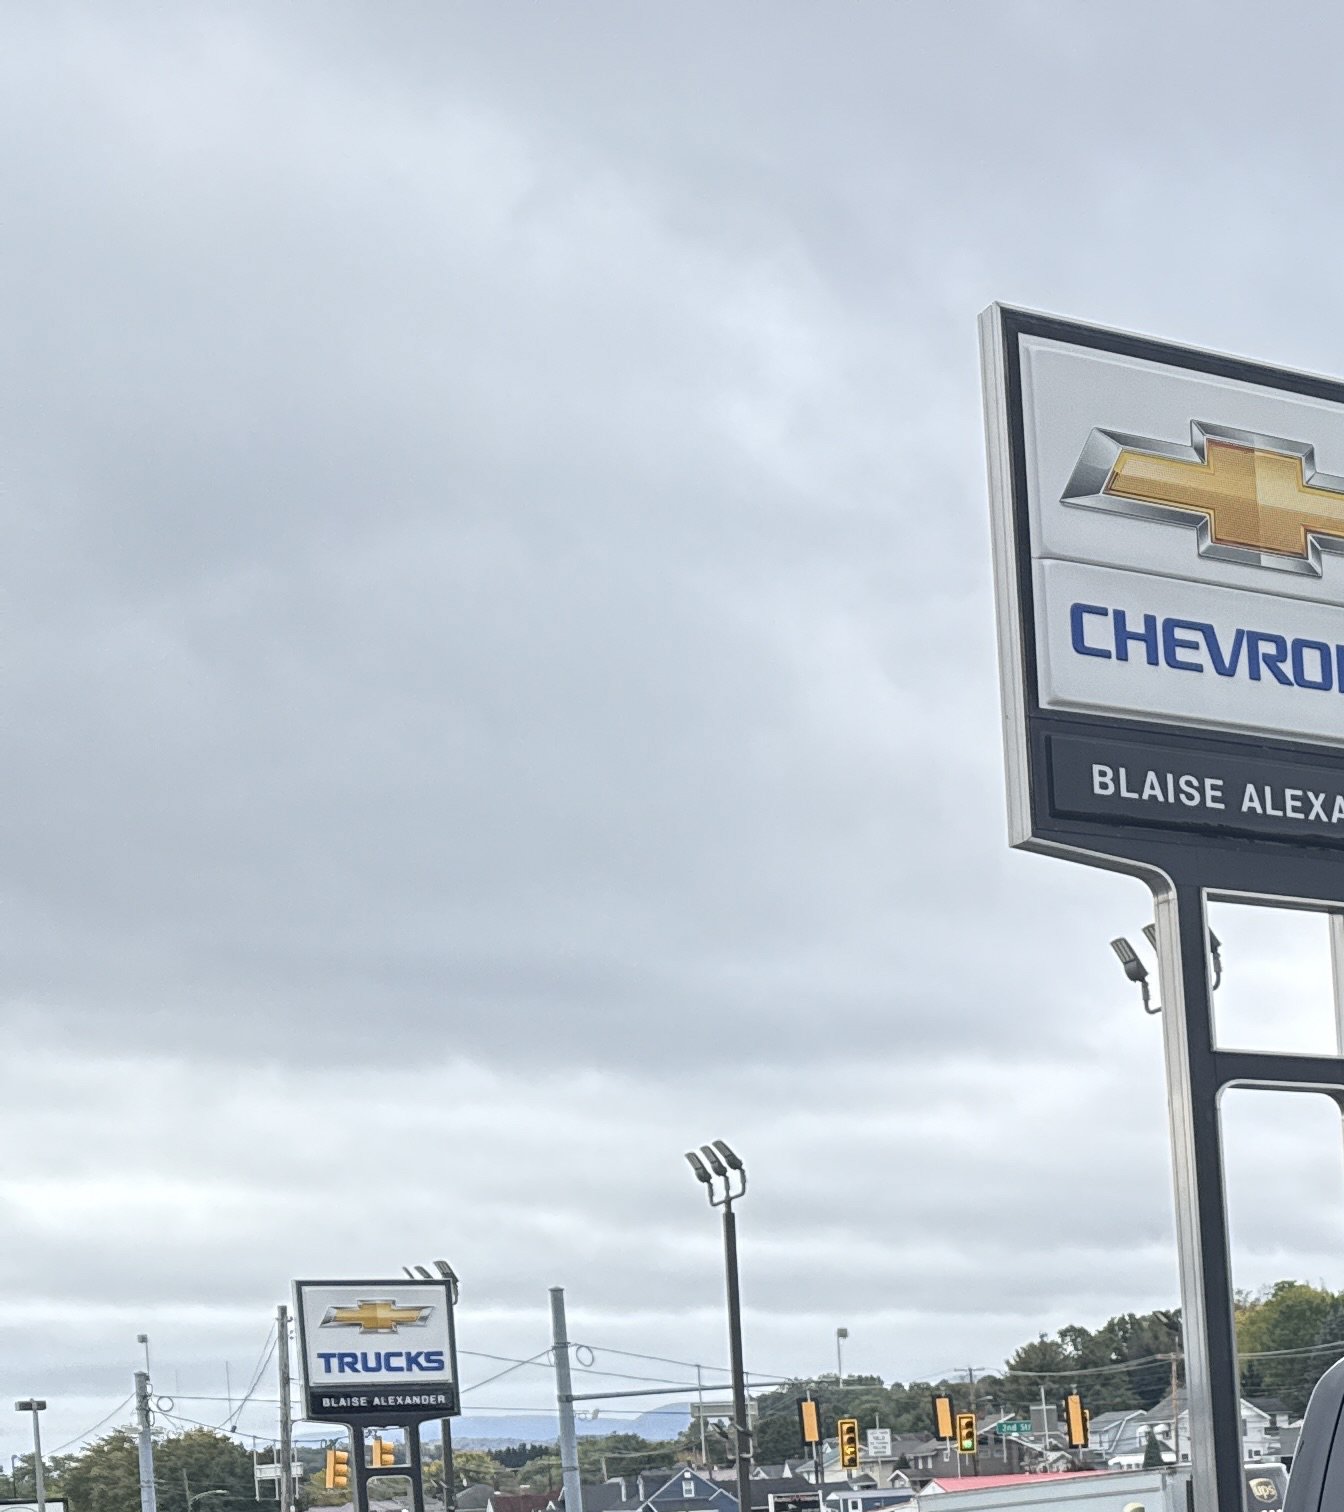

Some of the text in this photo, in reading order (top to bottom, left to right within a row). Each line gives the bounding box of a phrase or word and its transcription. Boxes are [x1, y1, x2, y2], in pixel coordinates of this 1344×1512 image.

[1092, 763, 1225, 809] BLAISE
[317, 1351, 445, 1373] TRUCKS
[322, 1395, 446, 1407] BLAISE ALEXANDER
[1254, 1485, 1276, 1499] ups
